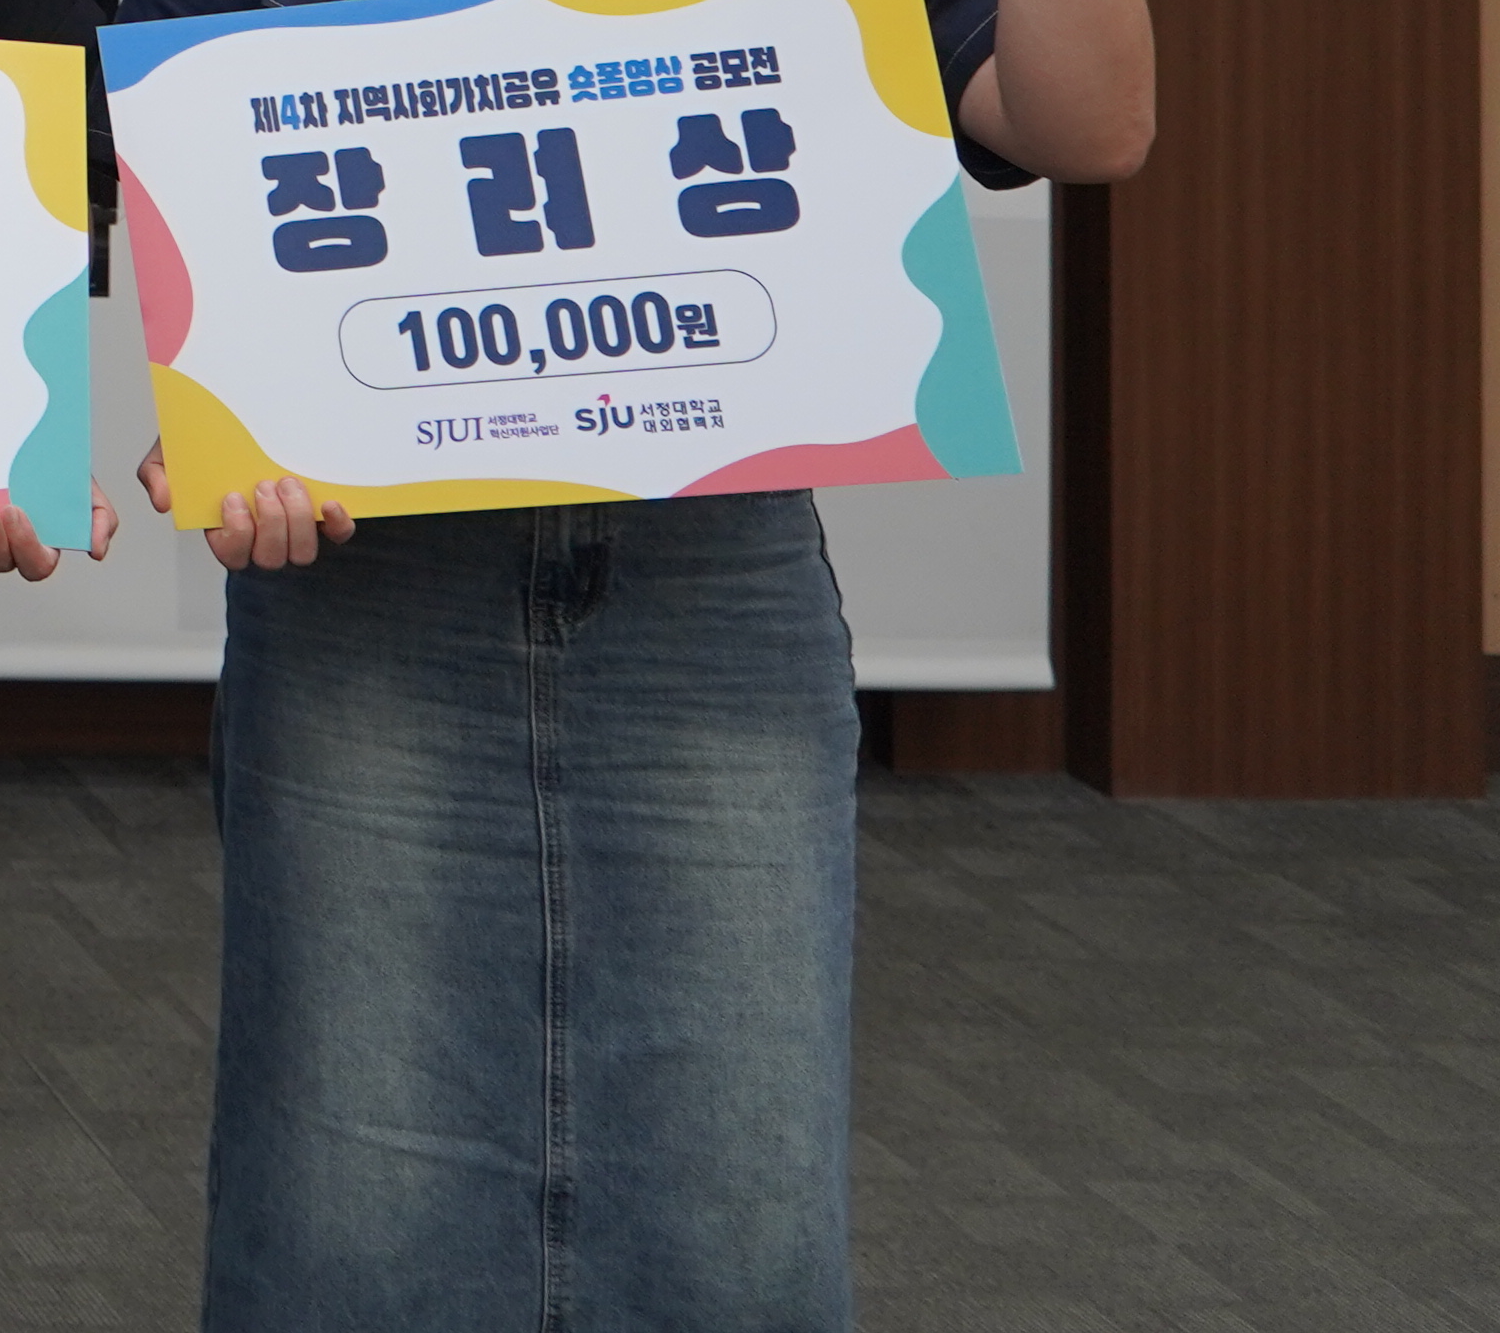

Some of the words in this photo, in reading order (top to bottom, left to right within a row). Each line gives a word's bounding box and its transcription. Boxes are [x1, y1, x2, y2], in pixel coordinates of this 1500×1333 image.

[249, 91, 329, 134] 제4차
[334, 67, 561, 126] 지역사회가치공유
[567, 55, 684, 103] 숏폼영상
[690, 45, 782, 91] 공모전
[396, 288, 719, 377] 100,000원
[640, 397, 723, 418] 서정대학교
[643, 413, 725, 435] 대외협력처
[415, 416, 487, 450] SJUI
